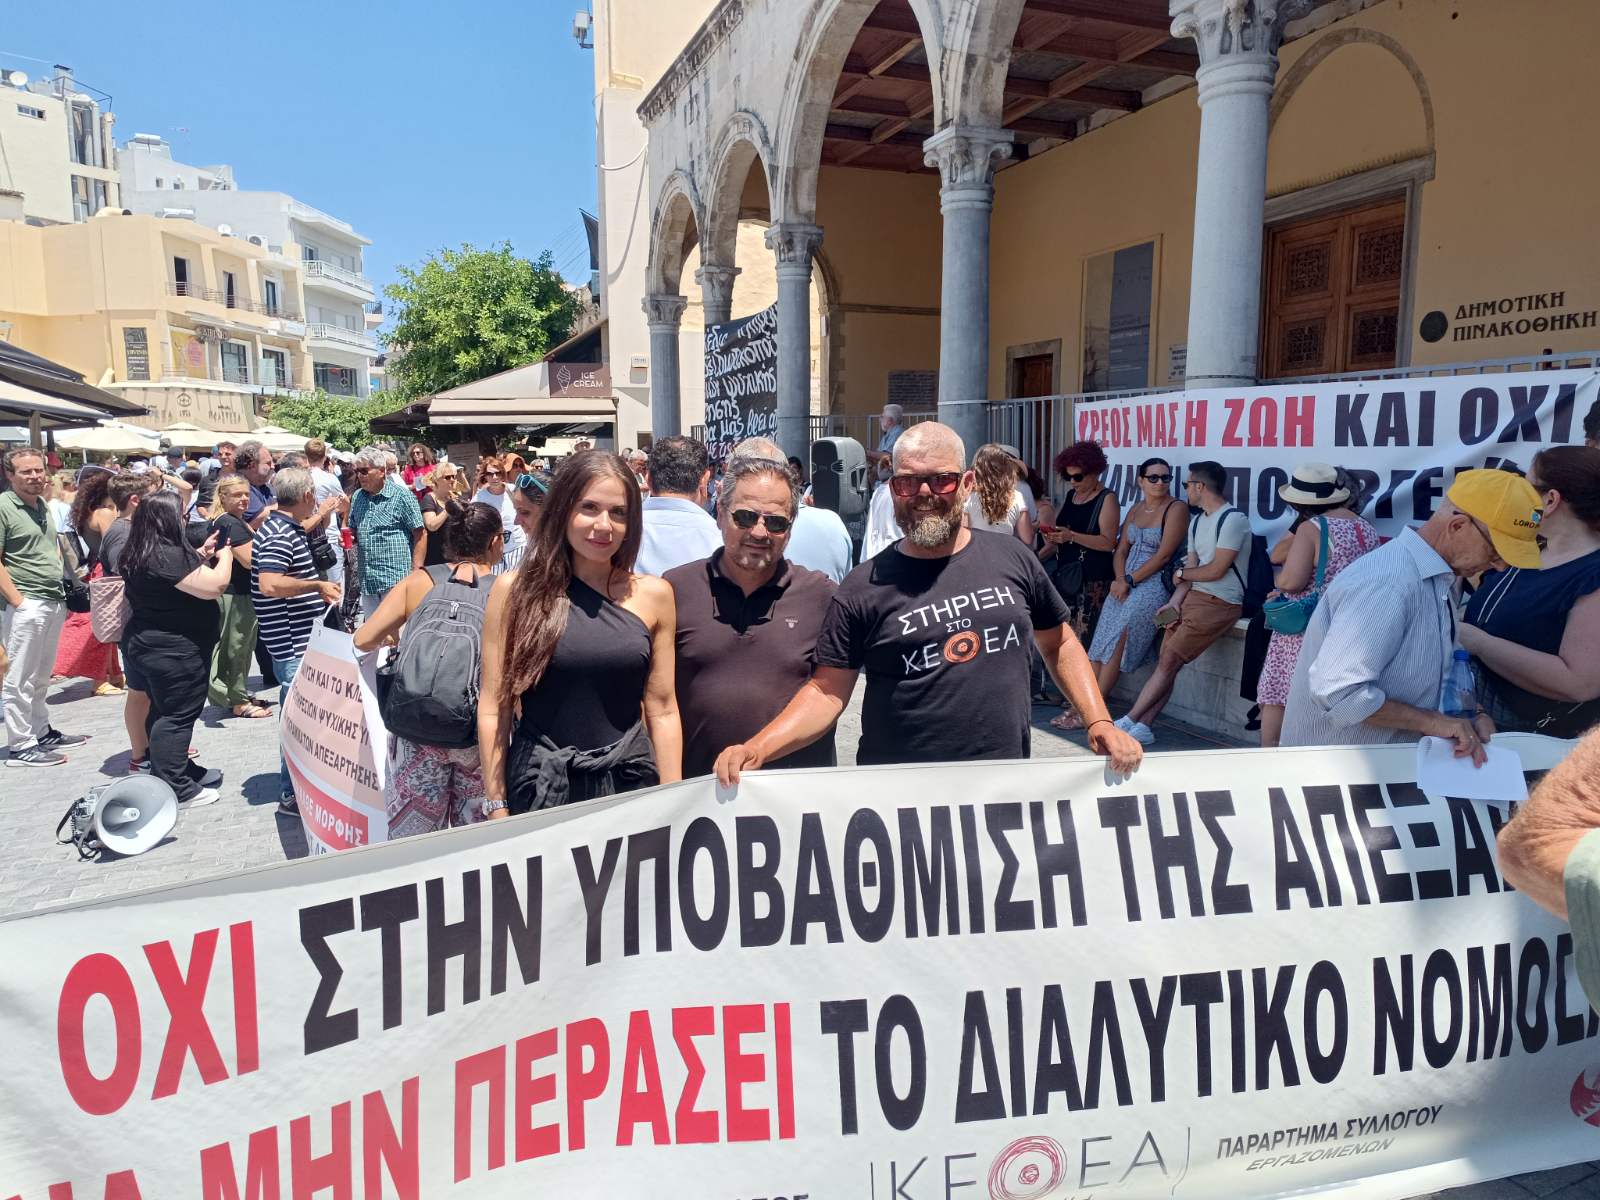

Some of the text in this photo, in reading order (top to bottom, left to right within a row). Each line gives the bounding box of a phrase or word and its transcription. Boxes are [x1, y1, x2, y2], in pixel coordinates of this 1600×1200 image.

[1455, 291, 1566, 321] ΔΗΜΟΤΙΚΗ
[1453, 311, 1598, 342] ΠΙΝΑΚΟΘΗΚΗ
[573, 380, 604, 388] CREAM
[581, 371, 596, 380] ICE
[1136, 402, 1179, 448] ΜΑΣ
[1184, 400, 1208, 447] Η
[1221, 395, 1316, 448] ΖΩΗ
[1334, 390, 1436, 447] ΚΑΙ
[1459, 383, 1578, 446] ΟΧΙ
[898, 586, 1016, 636] ΣΤΗΡΙΞΗ
[946, 618, 972, 633] ΣΤΟ
[901, 623, 1021, 675] ΚΕΘΕΑ
[315, 669, 329, 690] ΚΑΙ
[330, 676, 342, 695] ΤΟ
[318, 706, 359, 741] ΨΥΧΙΚΗΣ
[314, 743, 379, 792] ΑΠΕΞΑΡΤΗΣΗΣ
[315, 804, 364, 846] ΜΟΡΦΗΣ
[57, 769, 1552, 1116] ΟΧΙ ΣΤΗΝ ΥΠΟΒΑΘΜΙΣΗ ΤΗΣ ΑΠΕΞΑ
[454, 1002, 796, 1185] ΠΕΡΑΣΕΙ
[820, 993, 927, 1136] ΤΟ
[955, 959, 1349, 1124] ΔΙΑΛΥΤΙΚΟ
[1372, 932, 1600, 1076] ΝΟΜΟΣ
[1216, 1104, 1444, 1160] ΠΑΡΑΡΤΗΜΑ ΣΥΛΛΟΓΟΥ
[1245, 1136, 1396, 1172] ΕΡΓΑΖΟΜΕΝΩΝ
